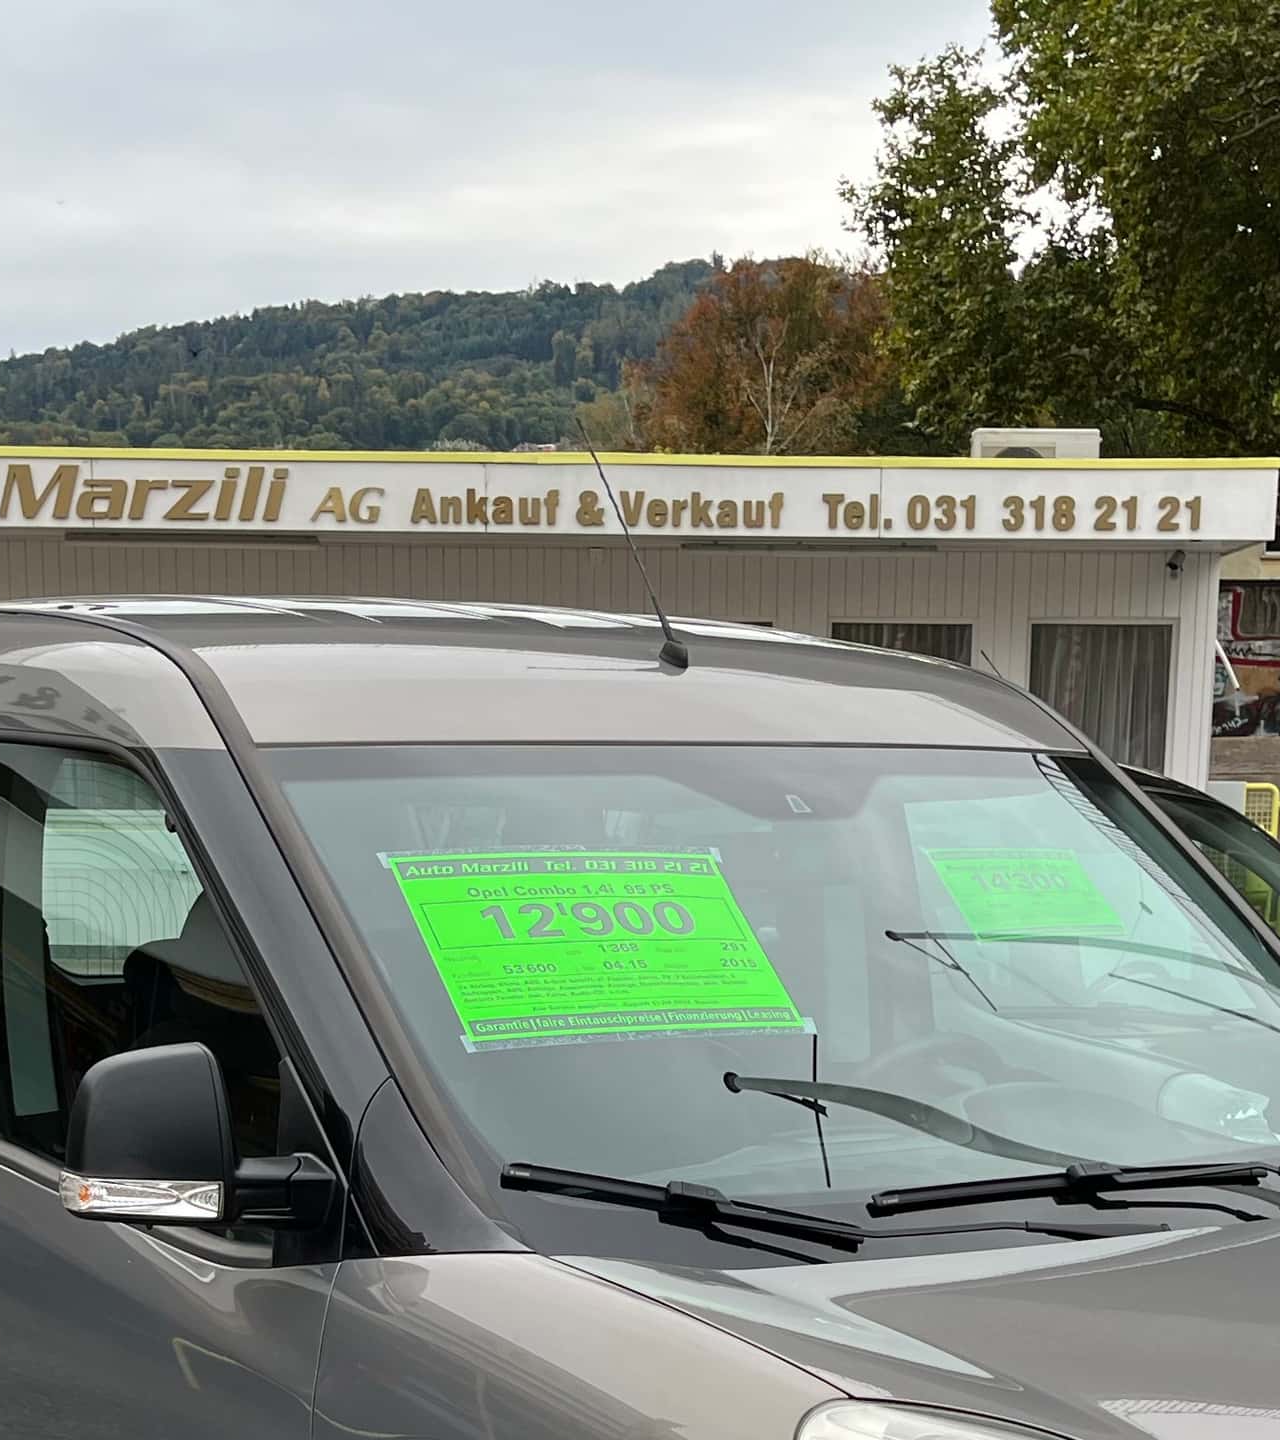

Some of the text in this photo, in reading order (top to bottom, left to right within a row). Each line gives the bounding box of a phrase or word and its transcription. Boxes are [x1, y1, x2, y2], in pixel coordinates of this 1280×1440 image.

[0, 463, 290, 522] Marzili
[311, 486, 386, 524] AG
[411, 486, 560, 526] Ankauf
[575, 489, 605, 526] &
[620, 488, 784, 530] Verkauf
[823, 493, 893, 530] Tel.
[907, 494, 978, 531] 031
[1002, 495, 1076, 532] 318
[1093, 495, 1139, 531] 21
[1157, 495, 1203, 531] 21
[405, 860, 708, 877] Auto Marzili Tel. 031 318 21 21
[467, 884, 509, 900] Opel
[513, 882, 577, 897] Combo
[649, 882, 675, 895] PS
[480, 900, 696, 940] 12'900
[603, 959, 648, 971] 04.15
[721, 957, 758, 969] 2015
[747, 1009, 790, 1020] Leasing
